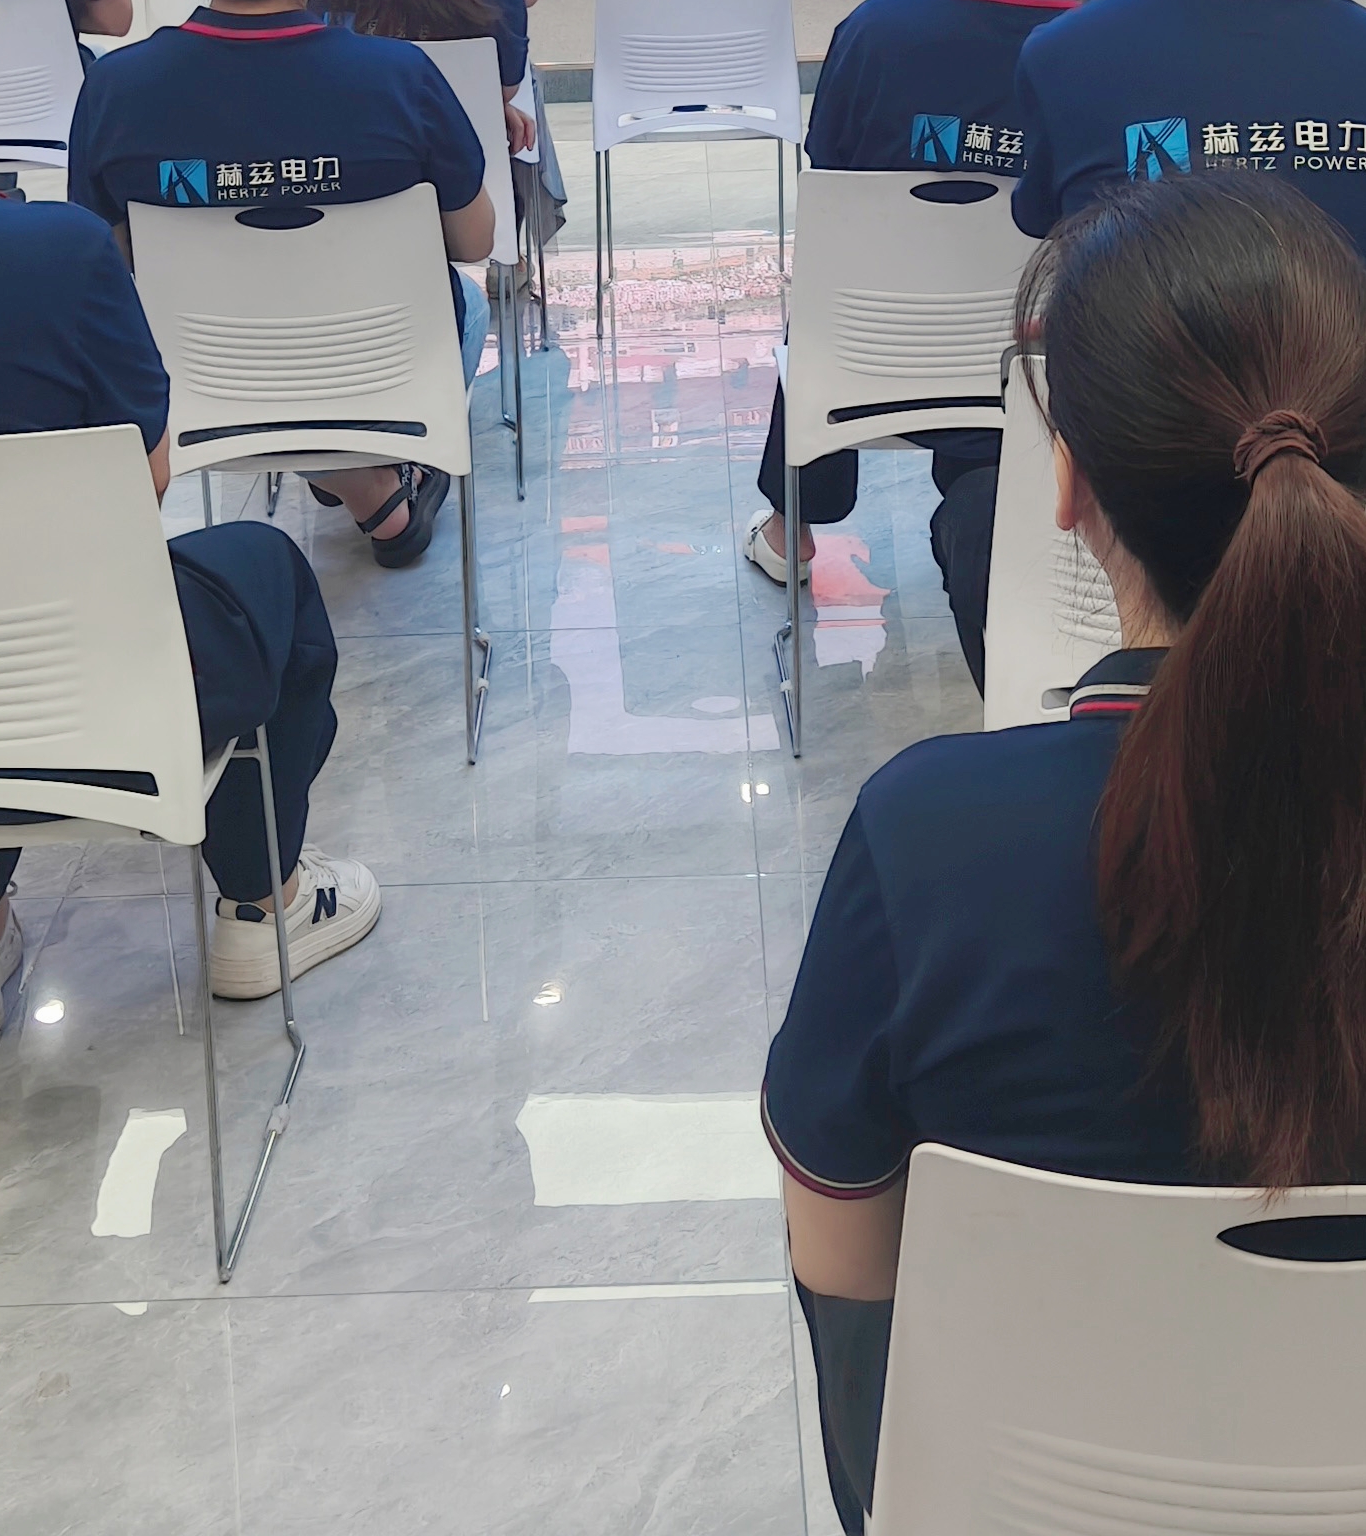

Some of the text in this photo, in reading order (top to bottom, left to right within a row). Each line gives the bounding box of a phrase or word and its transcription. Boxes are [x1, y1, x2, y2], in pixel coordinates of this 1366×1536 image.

[216, 156, 340, 187] 赫兹电力
[962, 150, 1015, 169] HERTZ
[217, 181, 342, 200] HERTZ POWER
[311, 886, 337, 925] N
